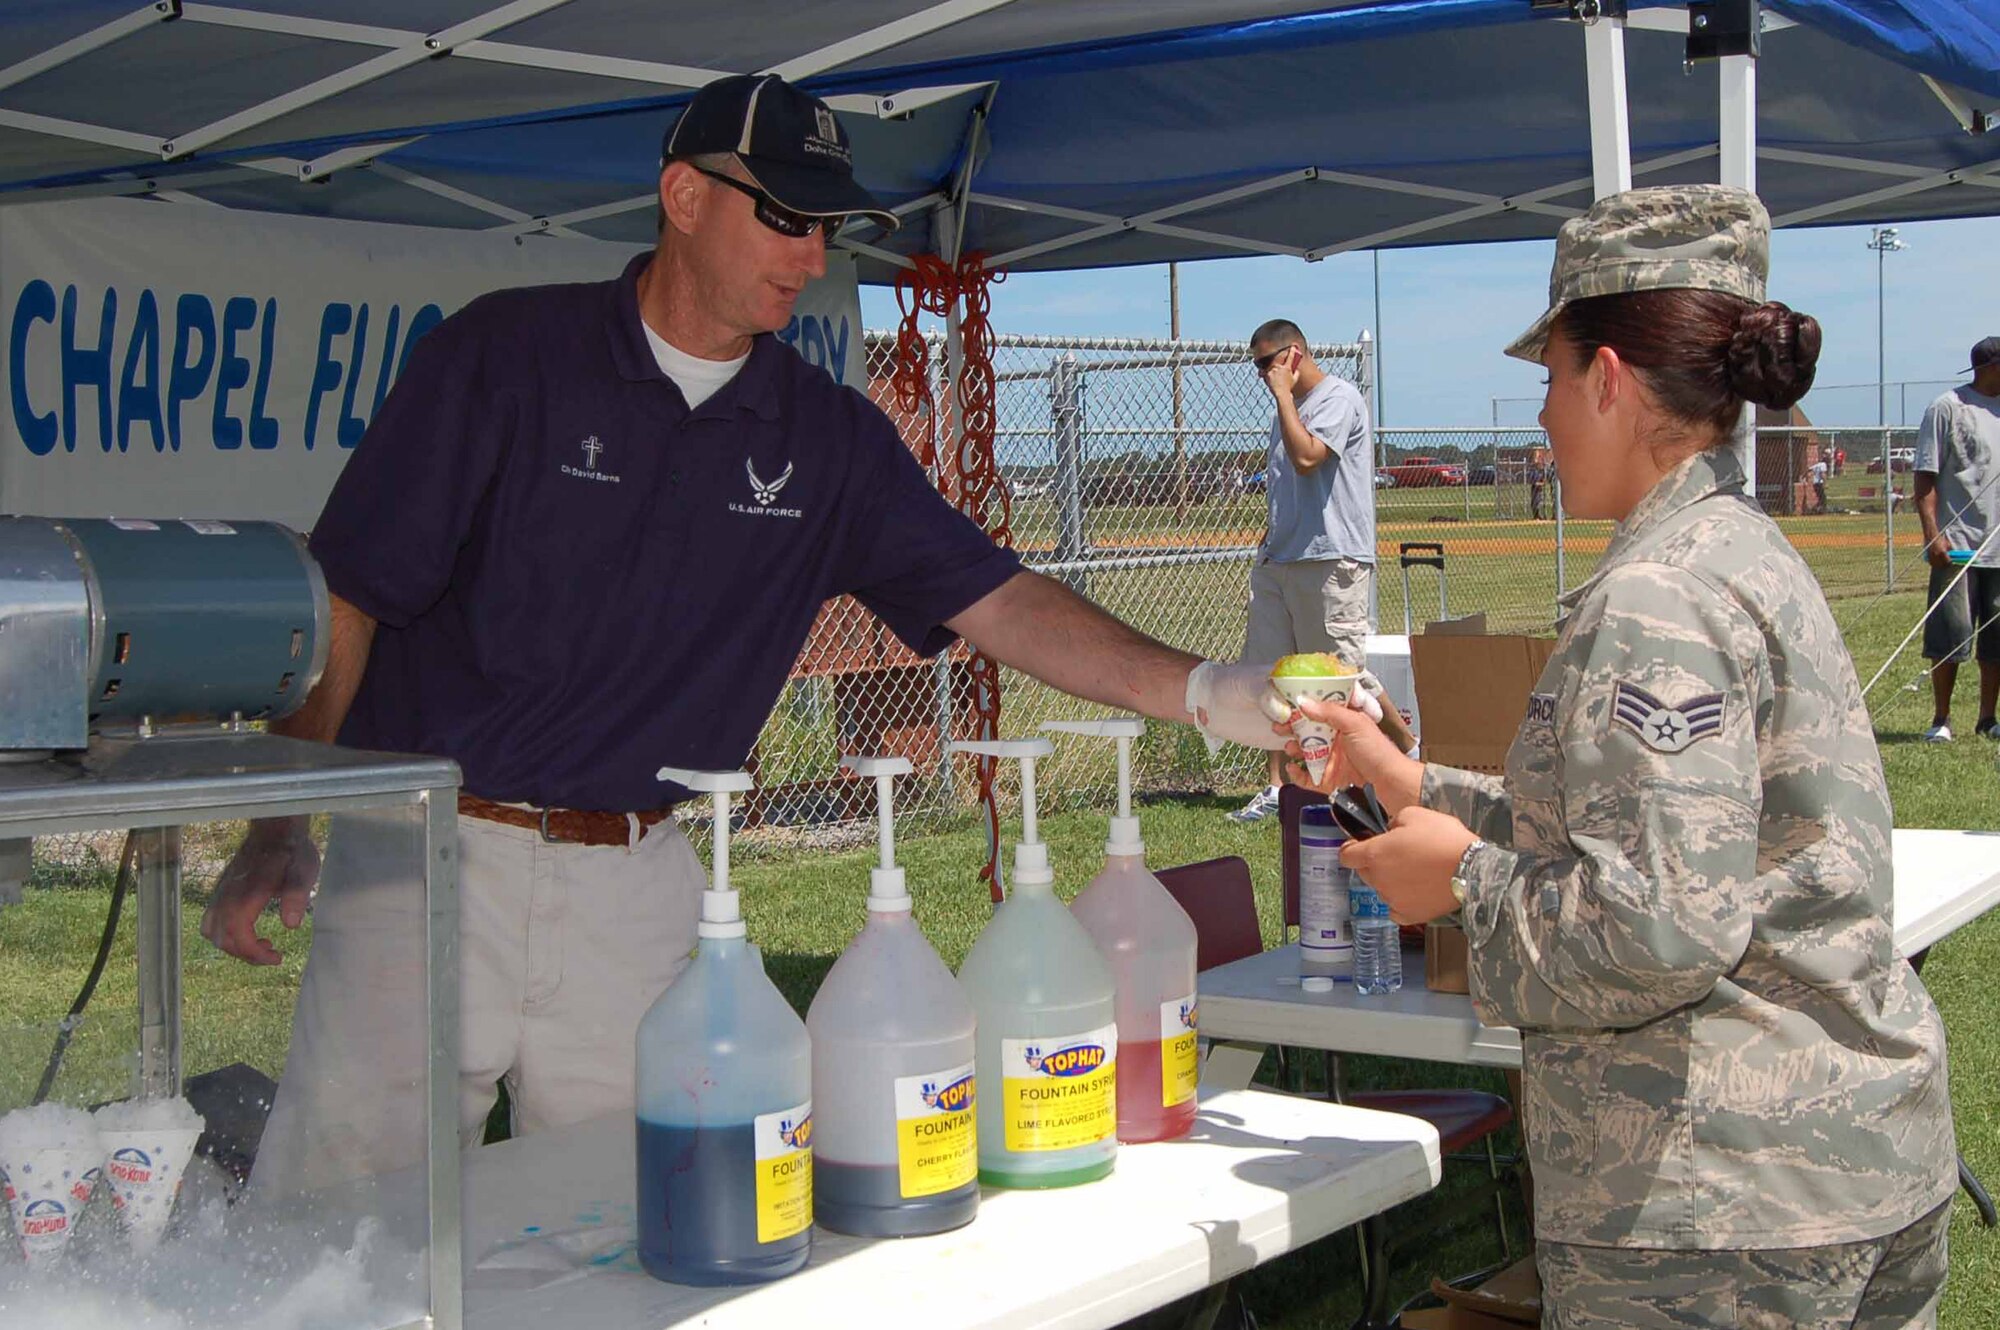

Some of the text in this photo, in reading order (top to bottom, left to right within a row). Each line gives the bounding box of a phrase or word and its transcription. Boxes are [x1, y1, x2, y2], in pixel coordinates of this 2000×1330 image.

[9, 279, 279, 456] CHAPEL
[572, 467, 595, 479] David
[746, 506, 764, 514] AIR
[766, 508, 802, 517] FORCE
[1020, 1082, 1089, 1101] FOUNTAIN
[915, 1113, 972, 1138] FOUNTAIN
[1017, 1118, 1042, 1129] LIME
[1045, 1112, 1095, 1128] FLAVORED
[917, 1151, 952, 1168] CHERRY
